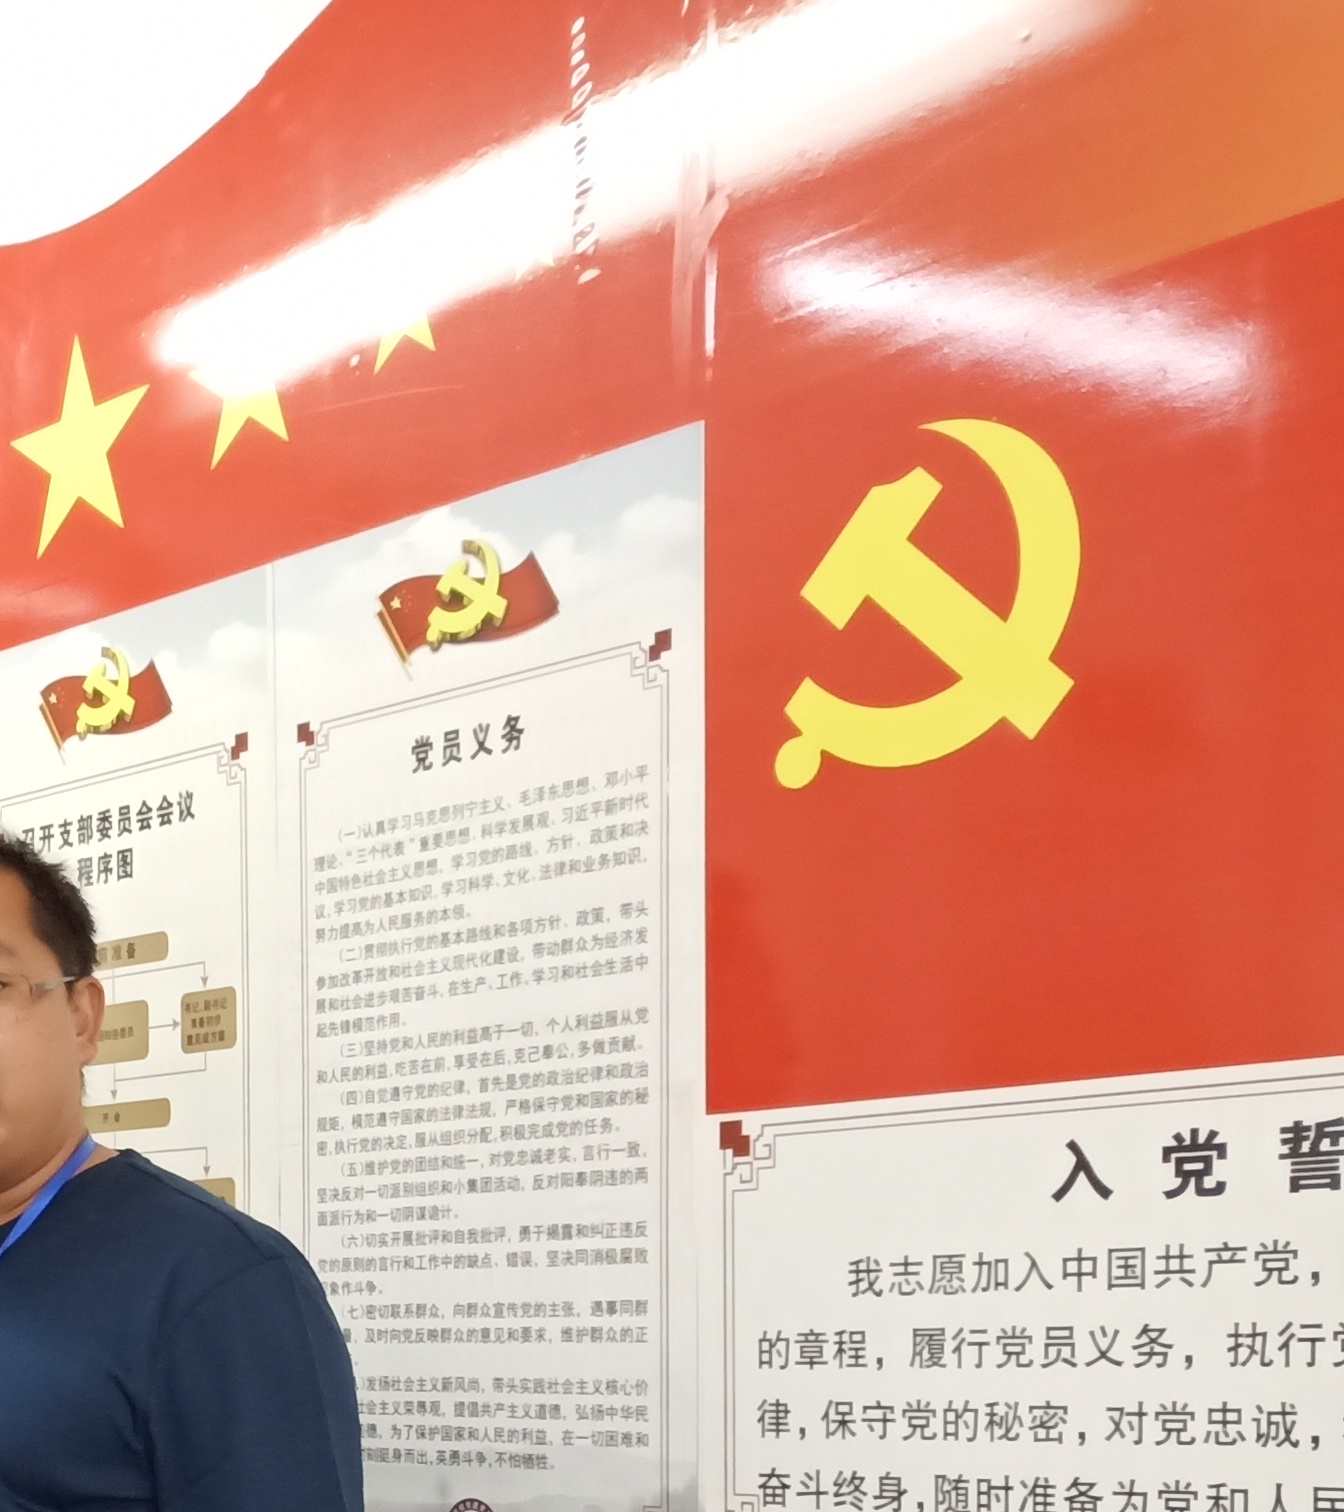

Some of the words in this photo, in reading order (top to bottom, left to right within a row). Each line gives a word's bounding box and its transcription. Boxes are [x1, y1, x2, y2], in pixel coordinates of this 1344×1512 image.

[410, 714, 525, 774] 党员义务
[21, 790, 196, 853] 召开支部委员会会议
[76, 848, 134, 888] 程序图
[315, 902, 471, 944] 努力提高为人民服务的本领。
[316, 1011, 407, 1038] 起先锋模范作用。
[317, 1203, 460, 1227] 面派行为和一切阴谋诡计。
[847, 1240, 1322, 1297] 我志愿加入中国共产党，
[757, 1399, 1344, 1451] 律，保守党的秘密，对党忠诚，
